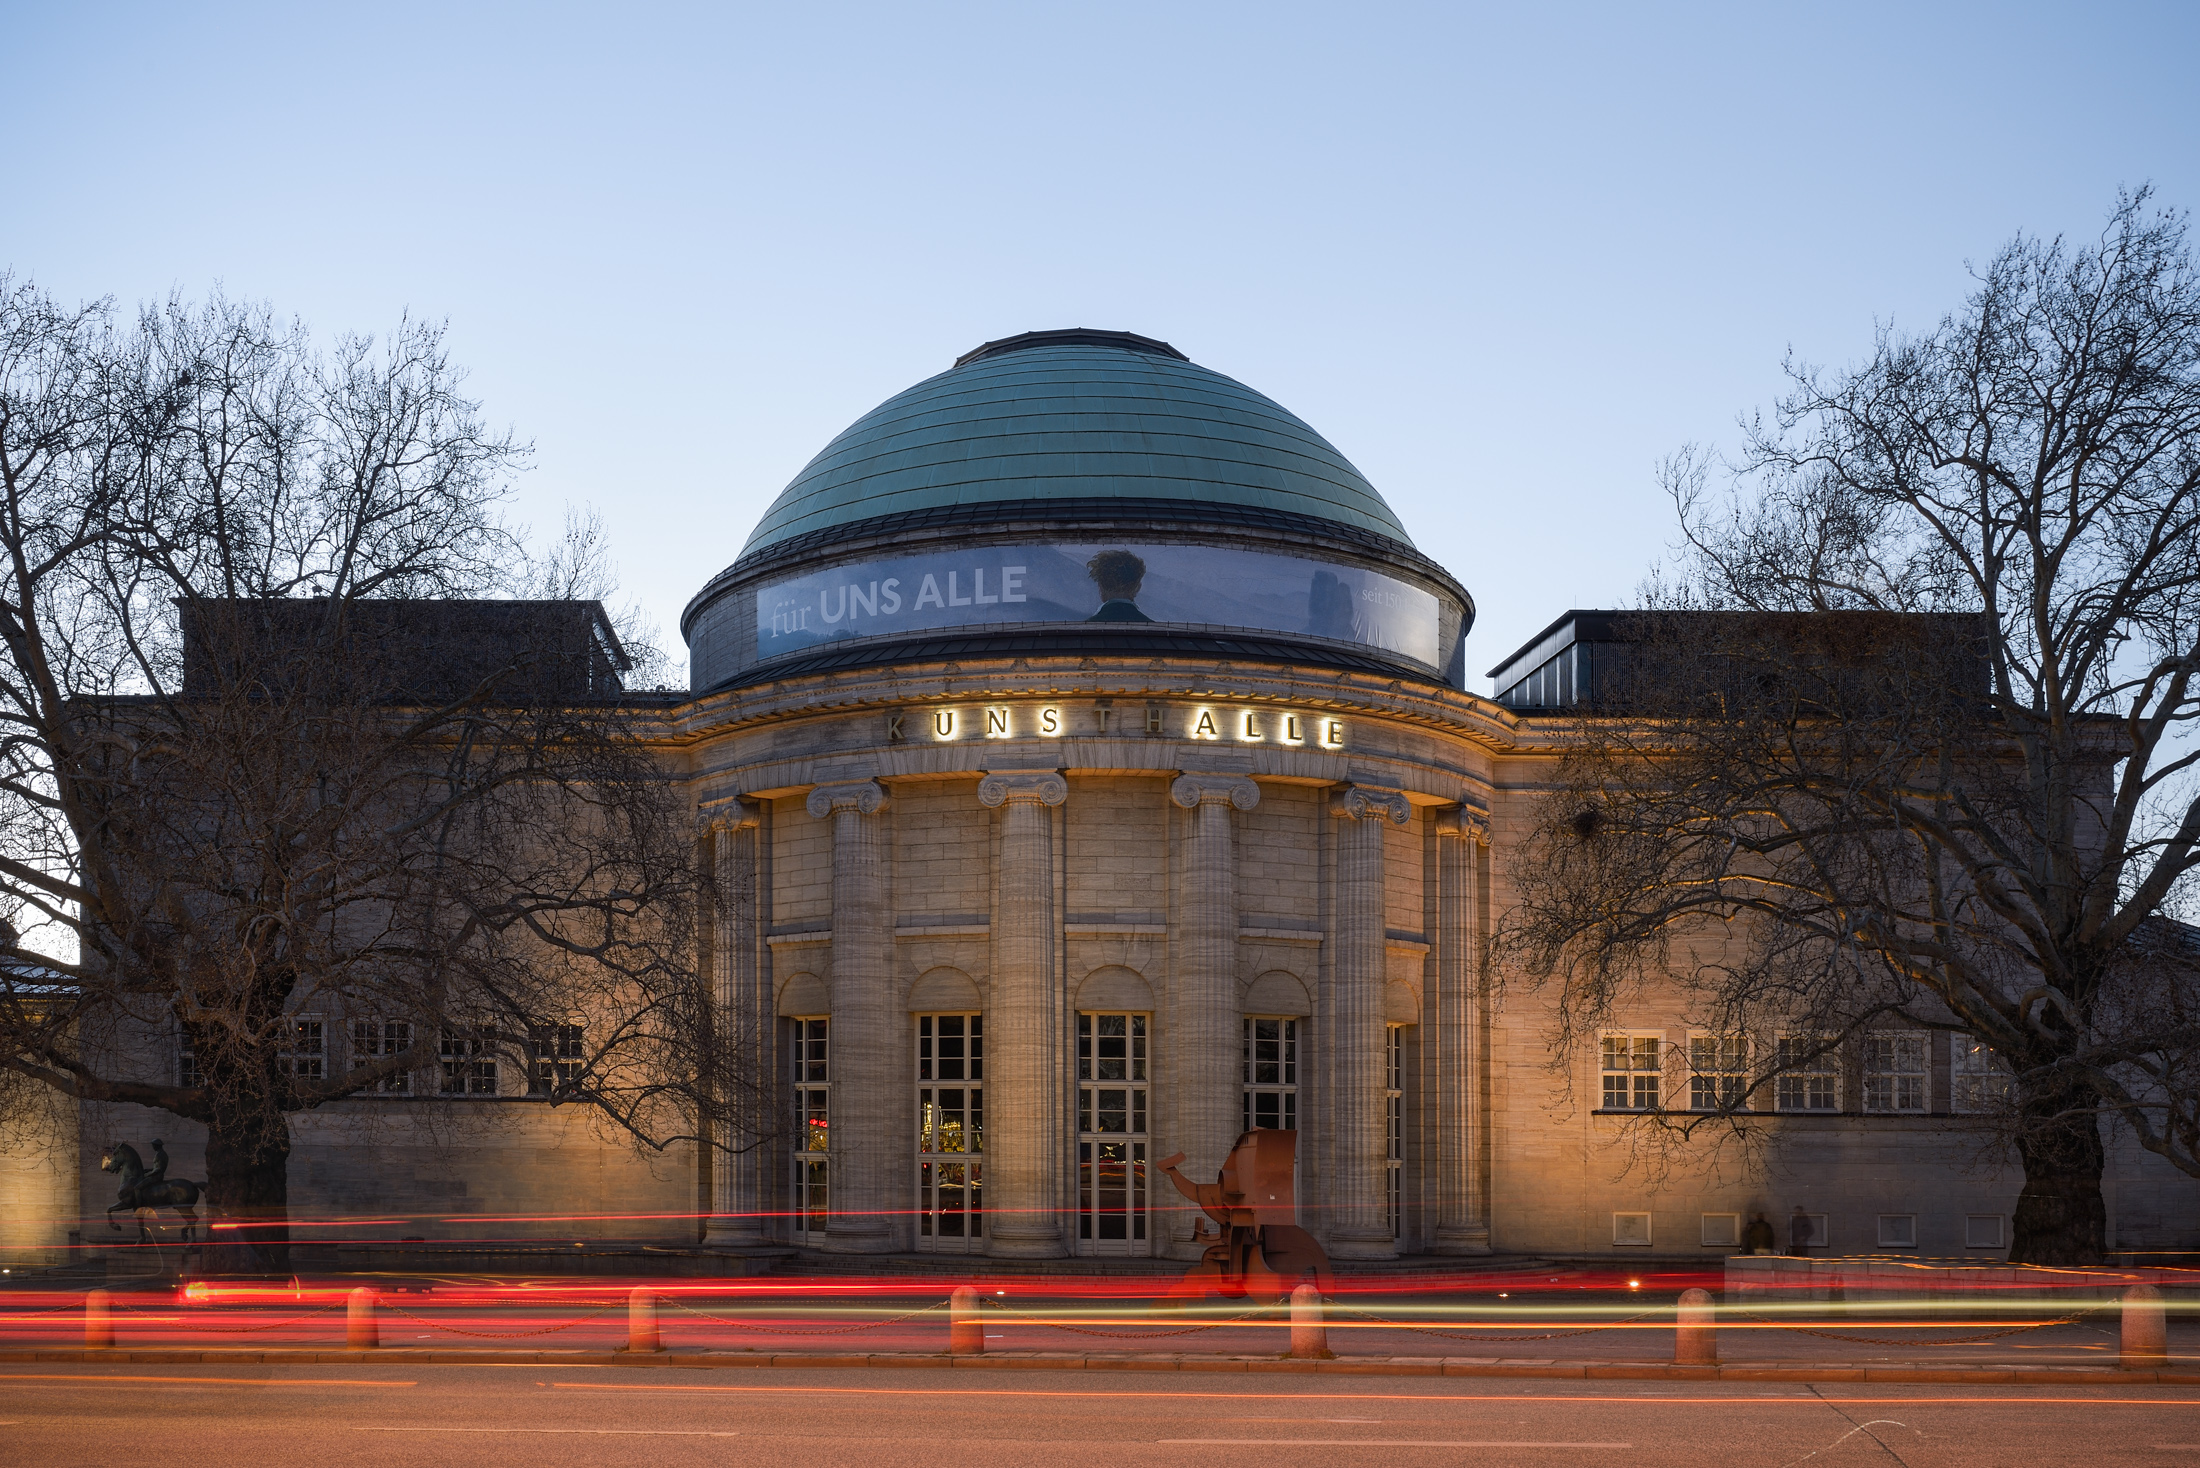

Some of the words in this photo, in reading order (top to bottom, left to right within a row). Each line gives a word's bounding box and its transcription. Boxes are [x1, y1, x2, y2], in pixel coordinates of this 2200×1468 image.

[770, 598, 811, 638] für
[819, 577, 902, 624] UNS
[913, 565, 1027, 611] ALLE
[1362, 587, 1382, 604] seit
[1384, 591, 1402, 610] 150
[887, 708, 1343, 745] KUNSTHALLE
